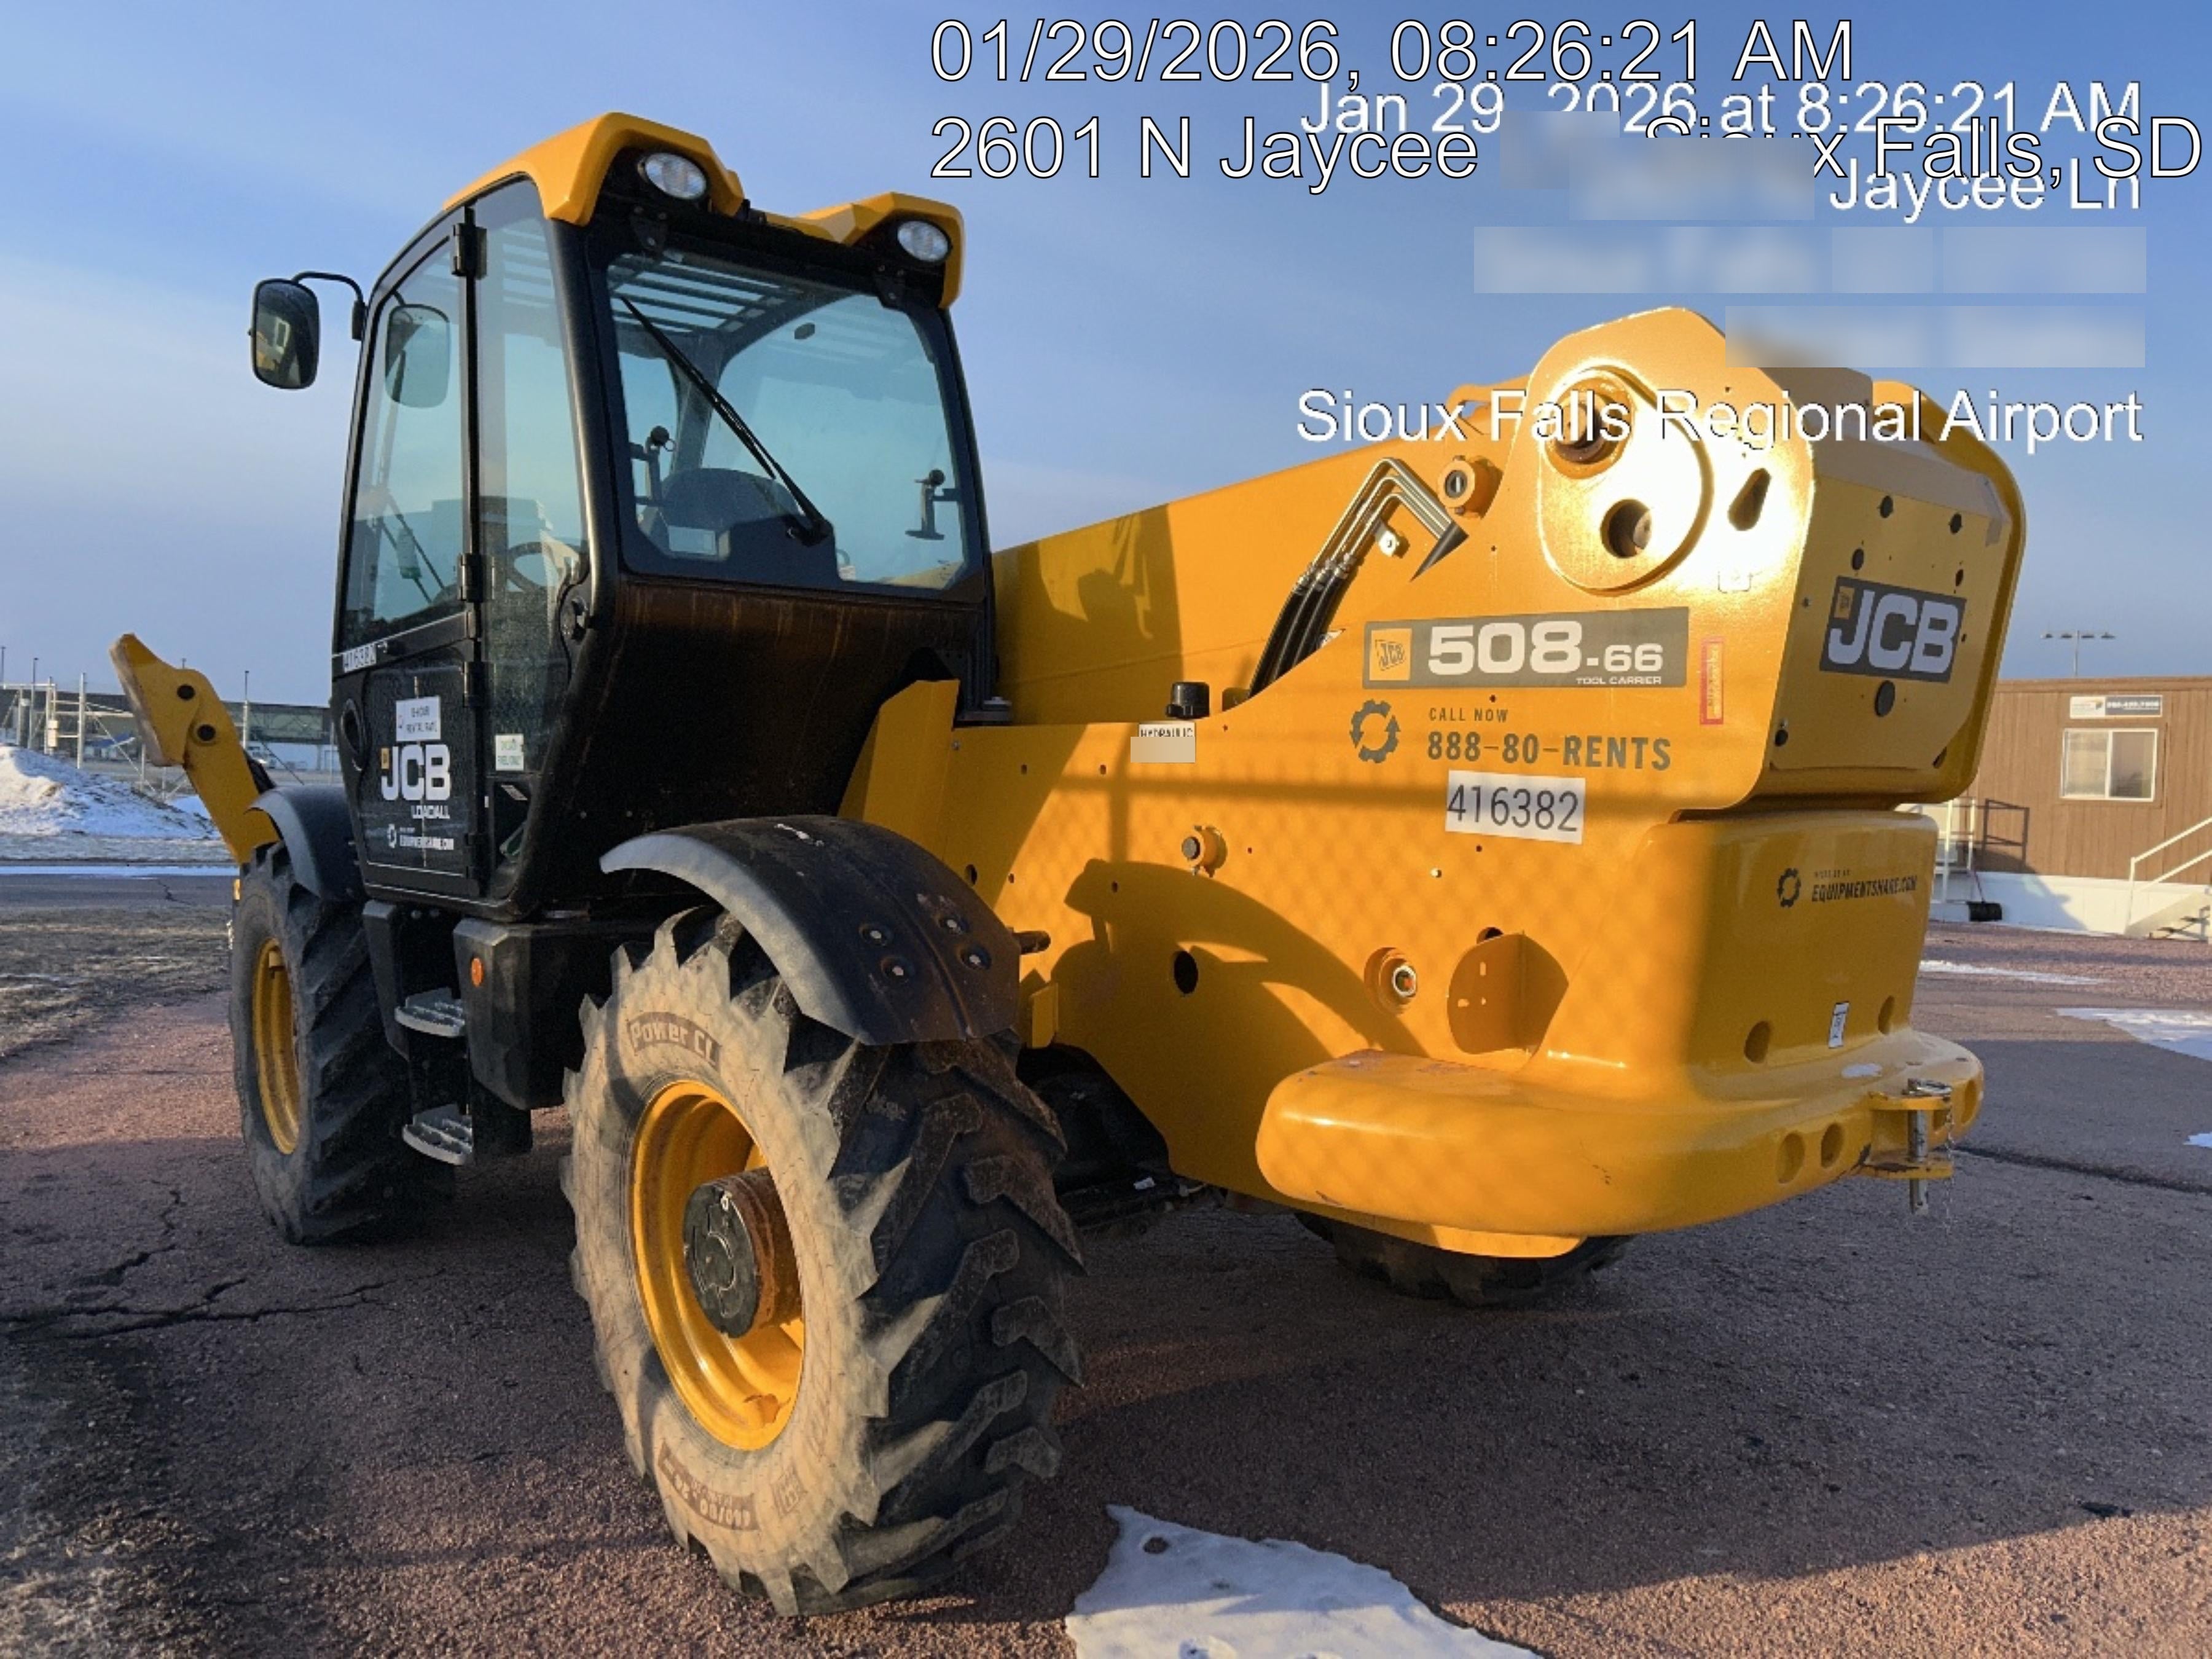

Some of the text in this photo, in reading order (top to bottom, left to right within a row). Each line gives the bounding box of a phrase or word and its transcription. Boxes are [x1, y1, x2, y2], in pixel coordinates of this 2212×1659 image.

[1827, 589, 1959, 674] JCB
[1378, 642, 1403, 667] JCB
[1575, 676, 1662, 685] TOOL CARRIER
[1429, 707, 1508, 723] CALL NOW
[1427, 731, 1671, 771] 888-80-RENTS
[381, 744, 451, 801] JCB
[1446, 784, 1579, 833] 416382
[629, 1021, 689, 1047] Power
